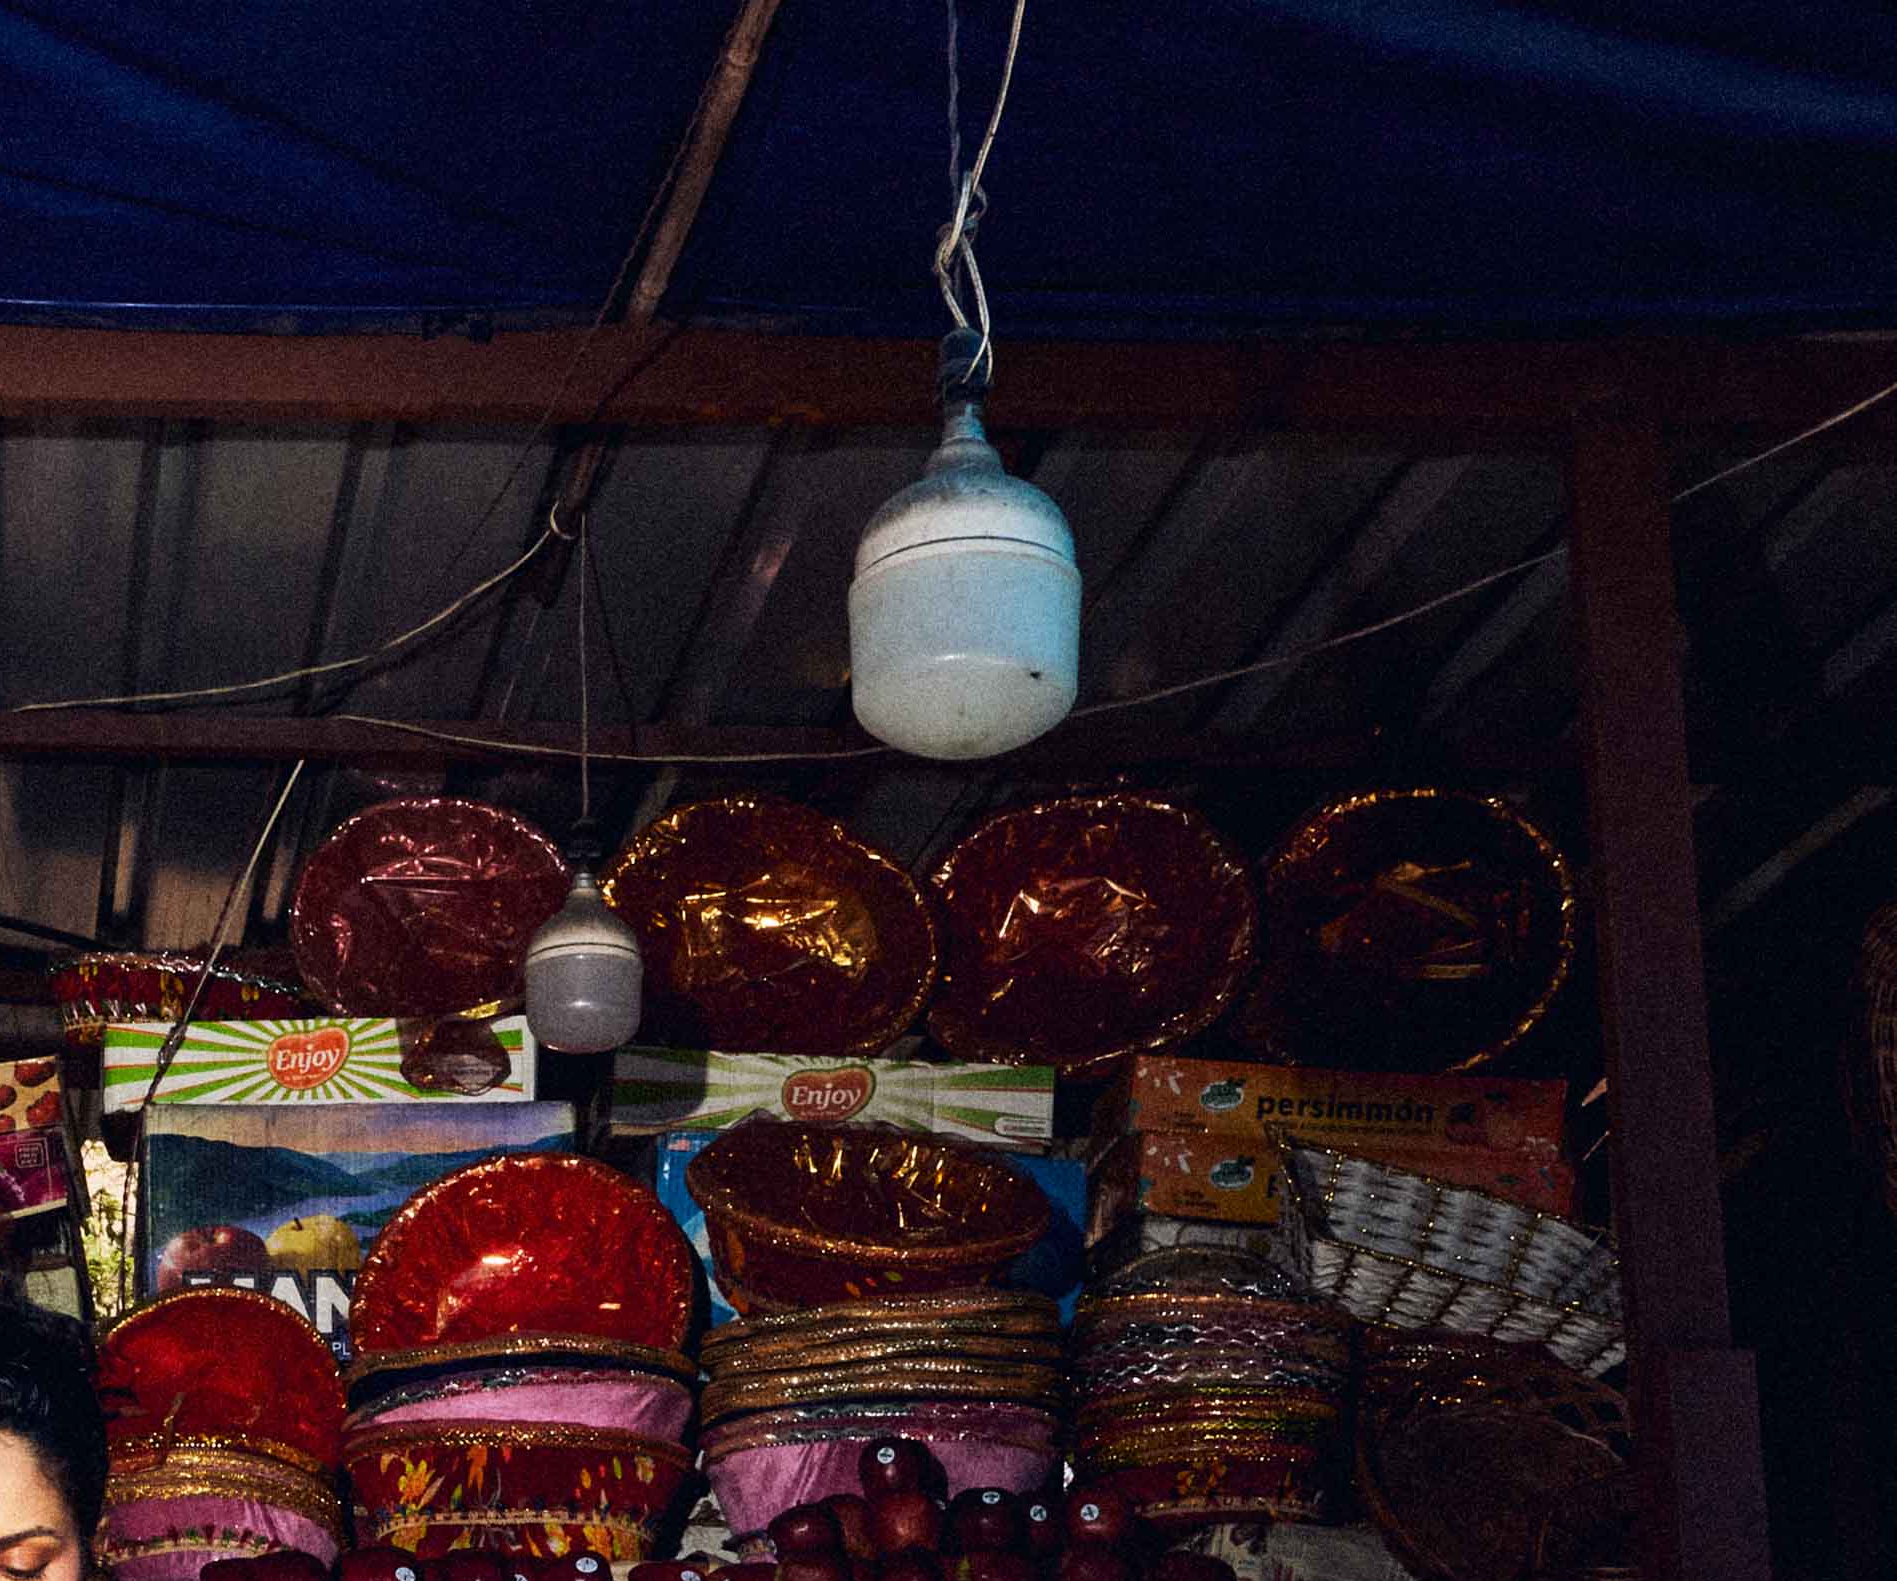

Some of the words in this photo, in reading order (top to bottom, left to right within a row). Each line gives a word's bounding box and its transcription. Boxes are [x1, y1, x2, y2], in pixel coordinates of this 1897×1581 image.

[276, 1043, 340, 1073] Enjoy
[792, 1083, 862, 1110] Enjoy
[1257, 1093, 1435, 1121] persimmon
